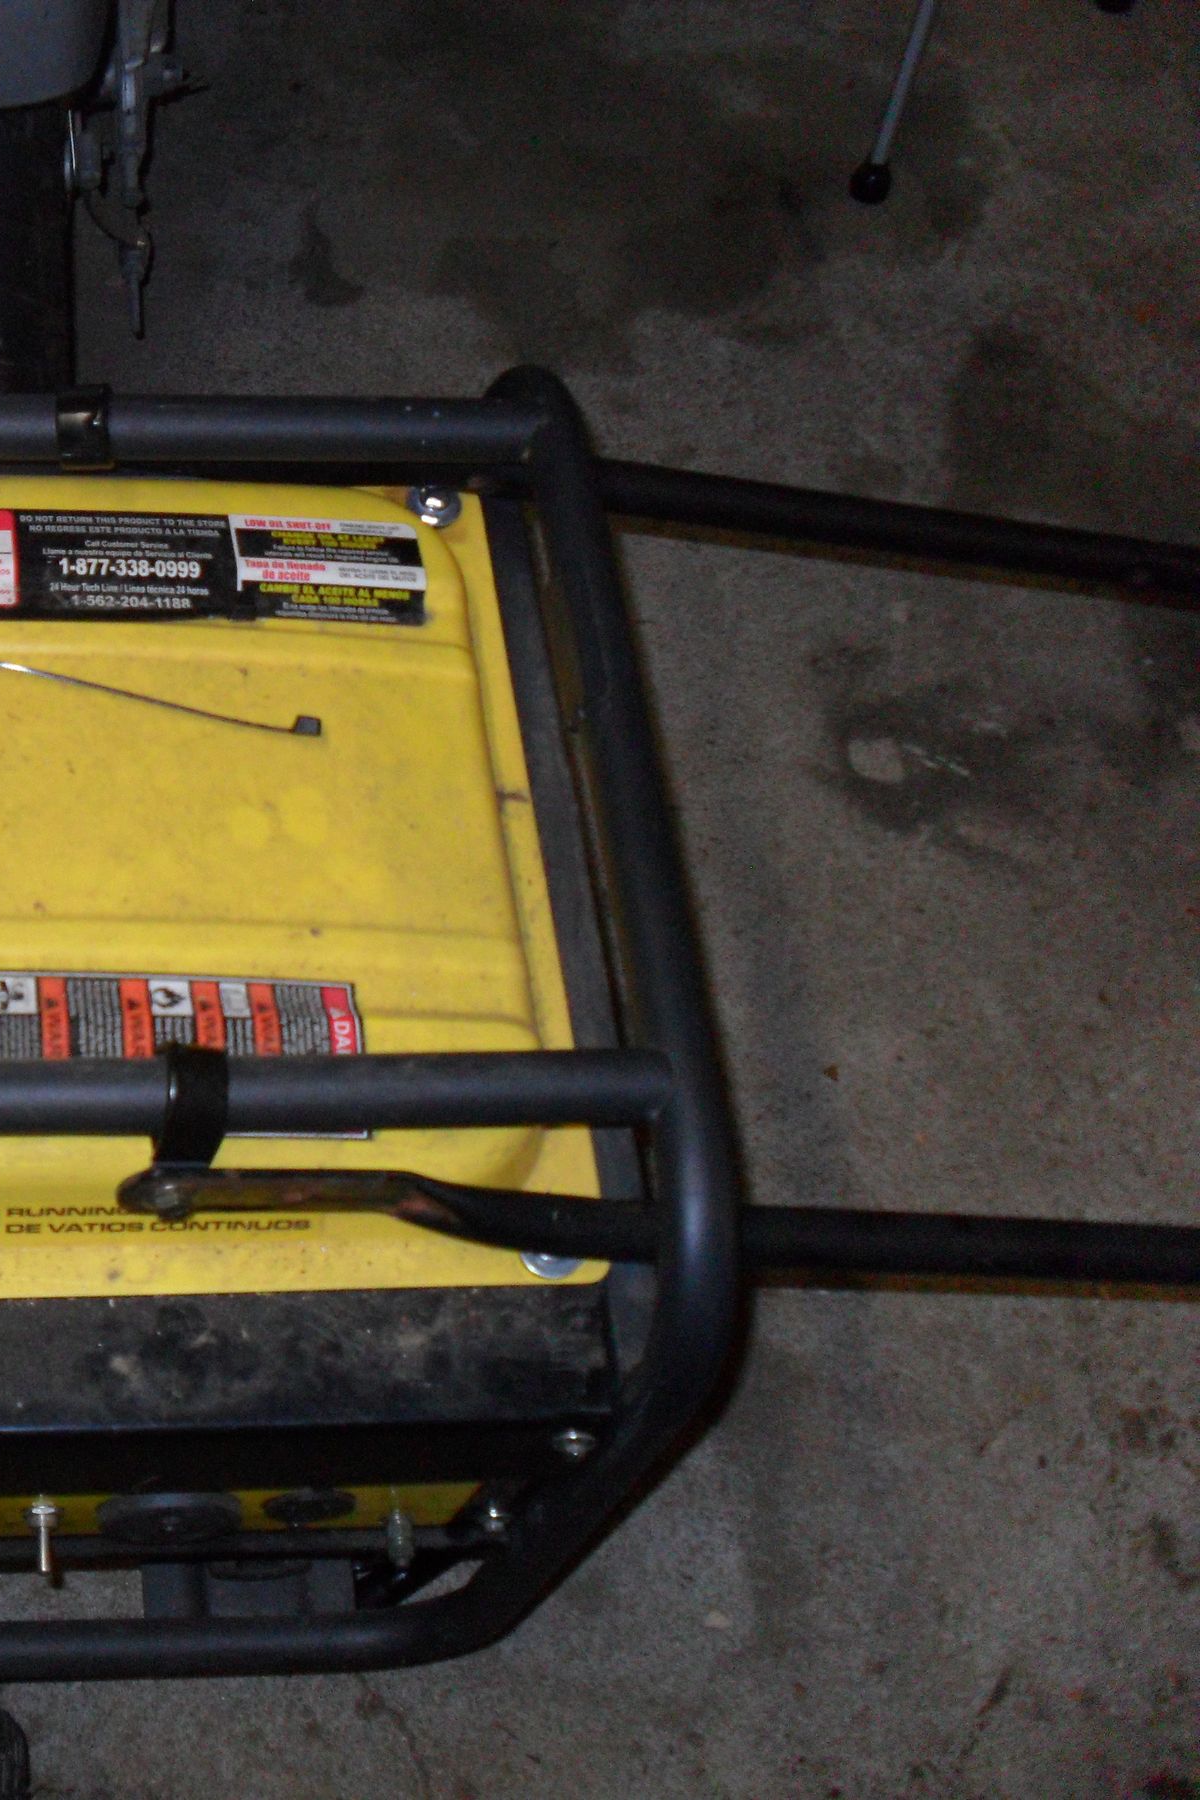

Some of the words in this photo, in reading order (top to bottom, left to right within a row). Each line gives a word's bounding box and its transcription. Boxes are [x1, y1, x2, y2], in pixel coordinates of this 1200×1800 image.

[35, 515, 54, 523] NOT
[96, 516, 117, 524] THIS
[118, 517, 160, 525] PRODUCT
[164, 518, 175, 526] TO
[177, 519, 195, 527] THE
[244, 519, 267, 528] LOW
[269, 520, 284, 528] OIL
[286, 521, 332, 531] SHUT-OFF
[28, 524, 43, 533] NO
[88, 526, 113, 534] ESTE
[113, 526, 163, 535] PRODUCTO
[173, 528, 186, 536] LA
[101, 540, 139, 548] Customer
[58, 557, 201, 579] 1-877-338-0999
[71, 594, 192, 610] 1-562-204-1188
[5, 1223, 41, 1234] DE
[47, 1222, 144, 1233] VATIOS
[150, 1219, 311, 1232] CONTINUOS
